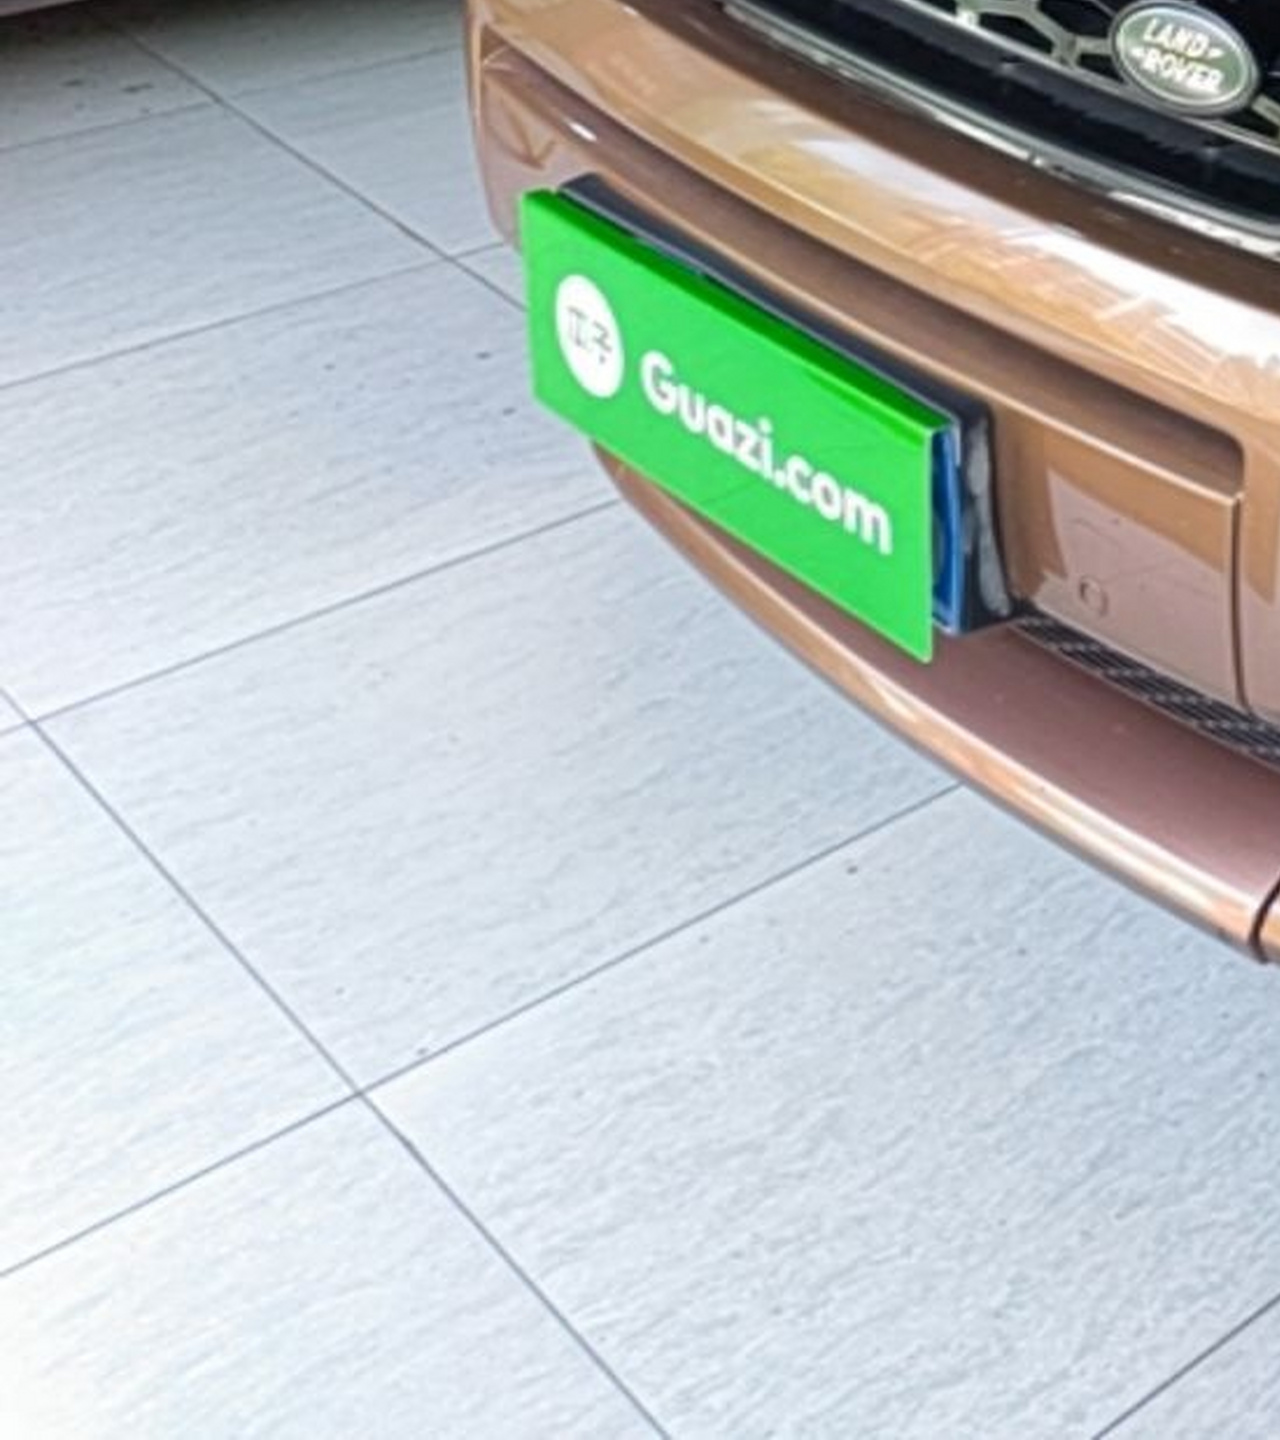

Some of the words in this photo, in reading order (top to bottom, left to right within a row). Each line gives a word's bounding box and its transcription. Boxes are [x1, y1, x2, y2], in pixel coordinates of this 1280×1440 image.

[1143, 17, 1210, 58] LAND
[1143, 47, 1224, 93] ROVER
[641, 350, 893, 555] Guazi.com
